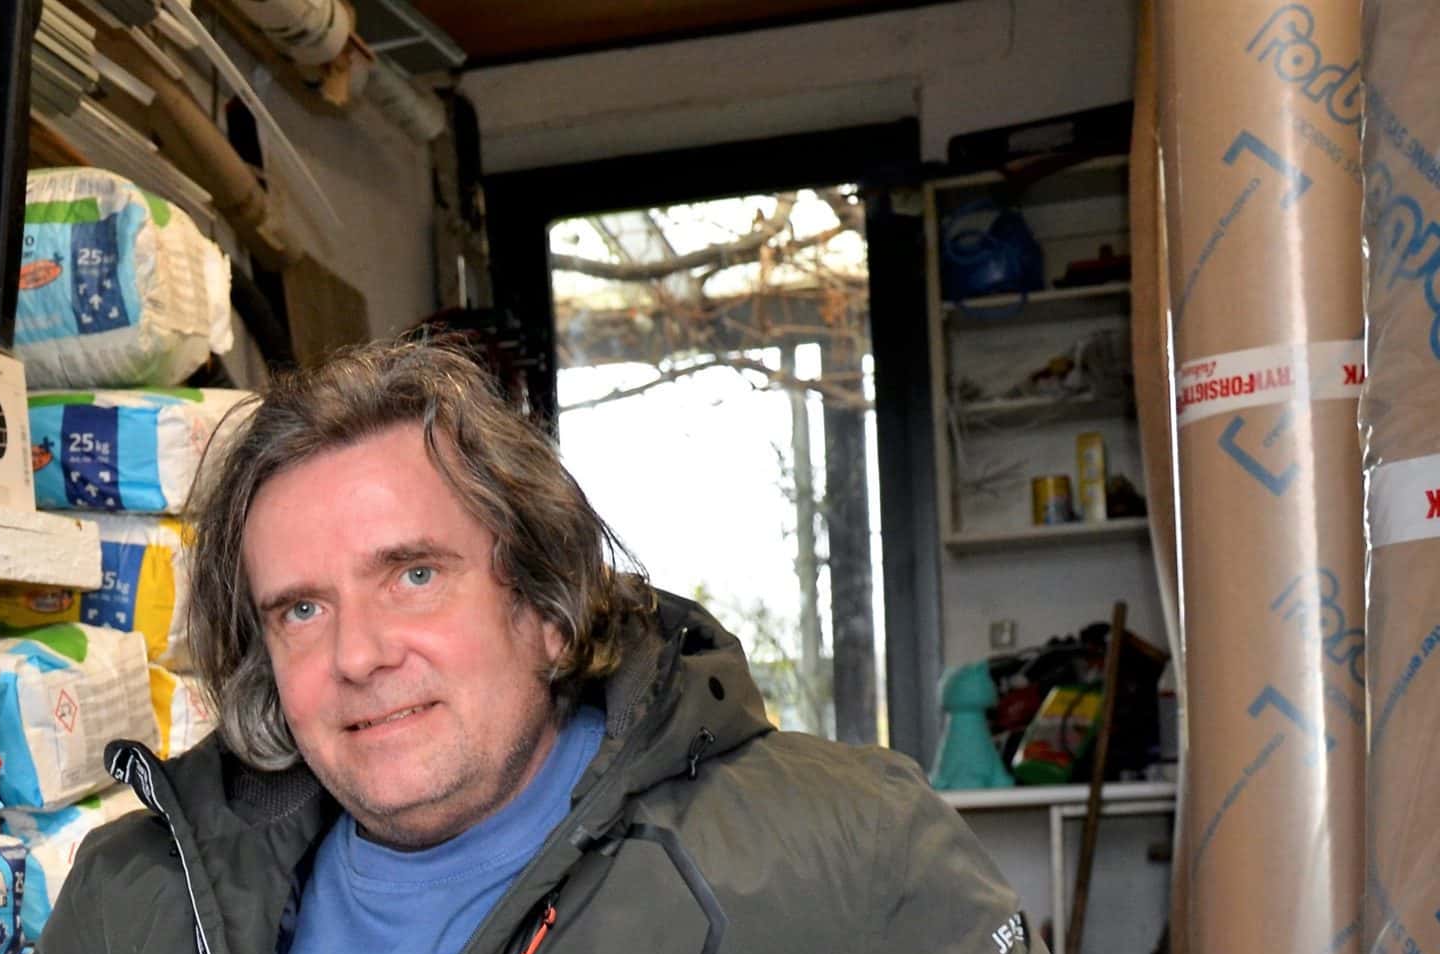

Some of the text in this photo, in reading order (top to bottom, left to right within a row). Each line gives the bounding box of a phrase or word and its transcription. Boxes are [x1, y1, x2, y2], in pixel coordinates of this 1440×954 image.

[1245, 3, 1363, 126] Forb
[77, 248, 102, 266] 25
[69, 433, 94, 453] 25
